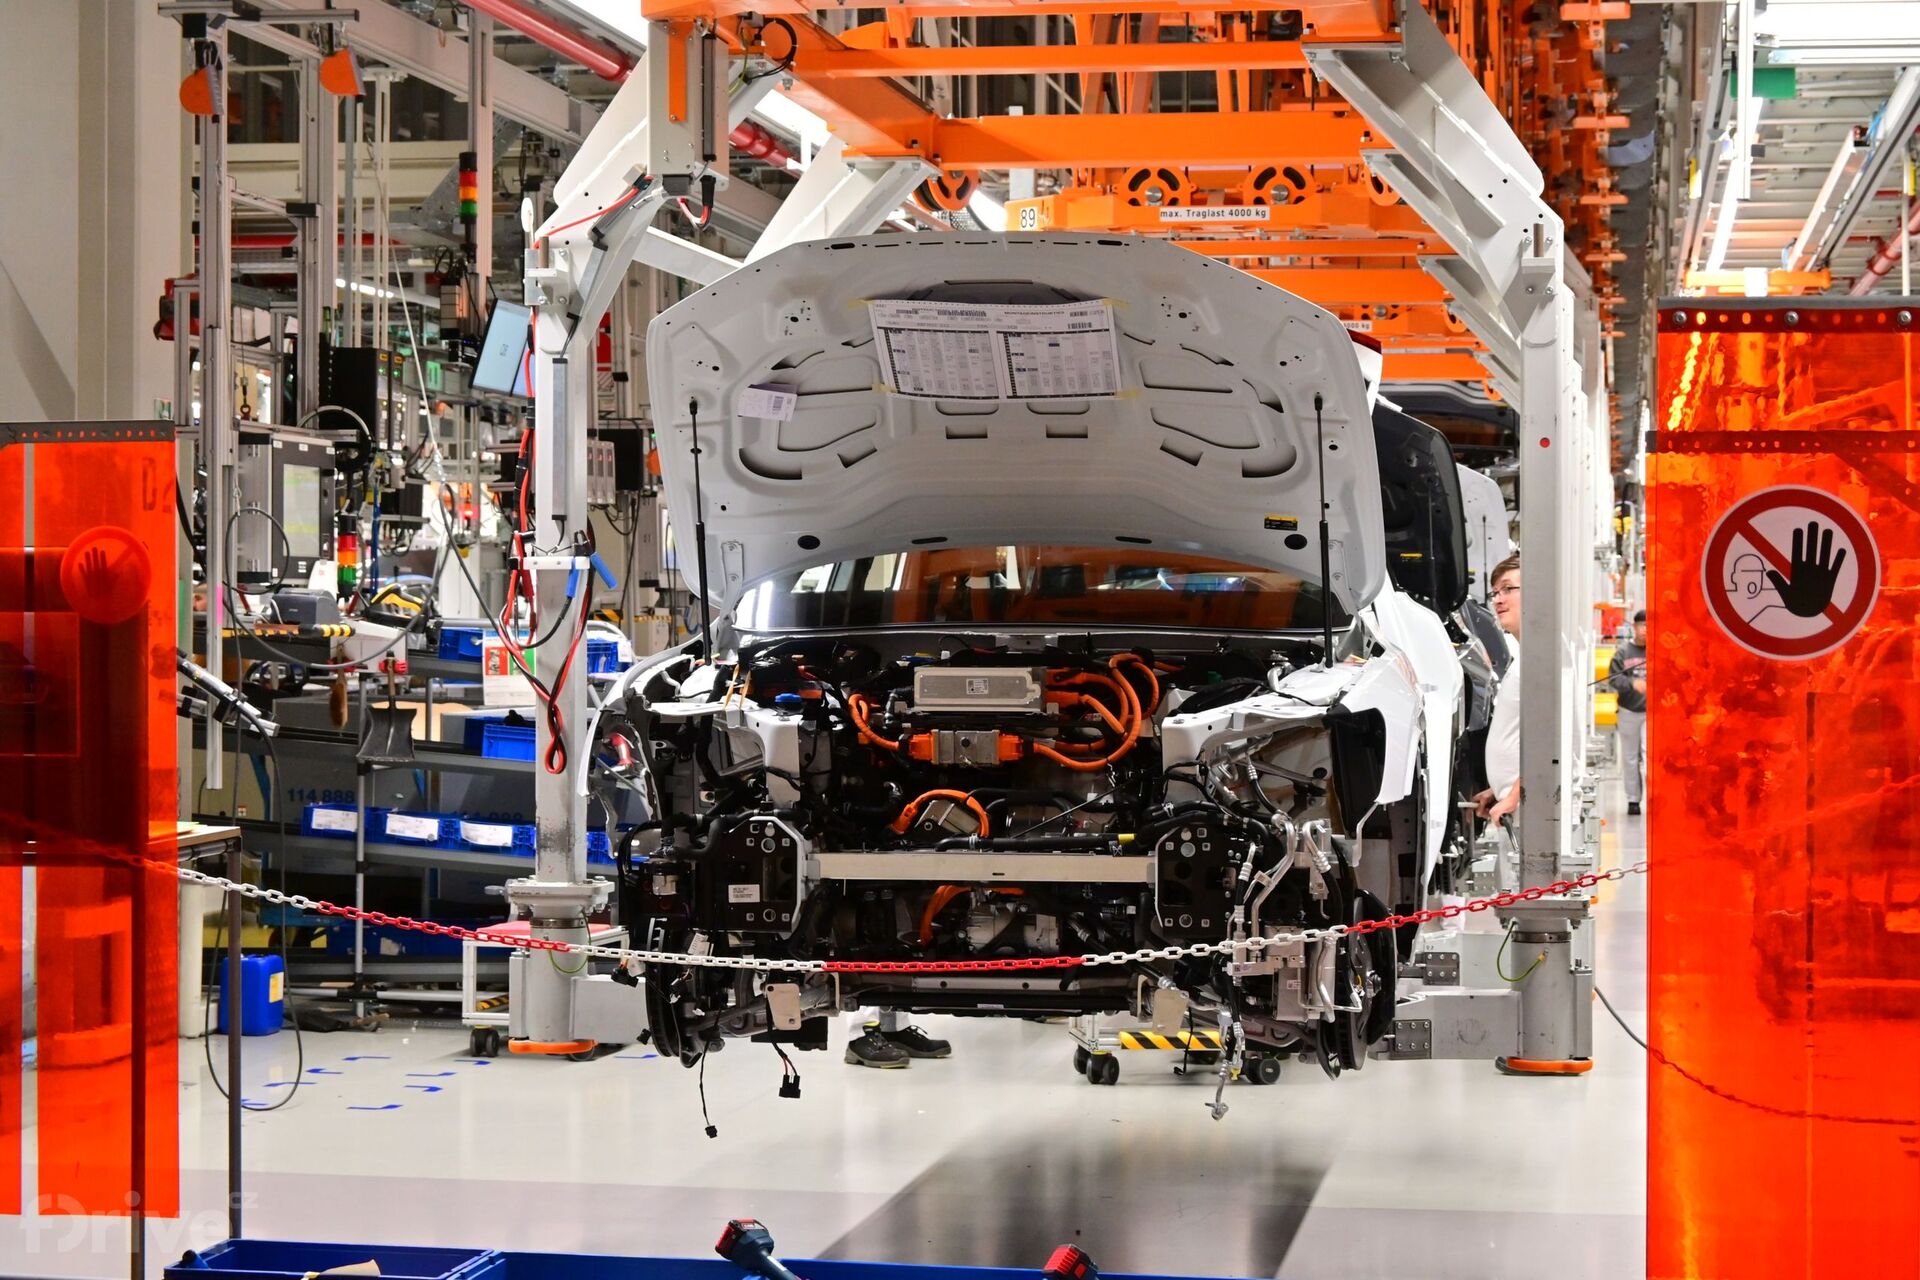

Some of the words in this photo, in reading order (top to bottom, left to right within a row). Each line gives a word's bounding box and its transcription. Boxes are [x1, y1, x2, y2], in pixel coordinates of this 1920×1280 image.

[1021, 208, 1035, 228] 89
[1160, 210, 1182, 218] max.
[1186, 209, 1225, 219] Traglast
[1228, 208, 1252, 217] 4000
[1255, 208, 1267, 218] kg
